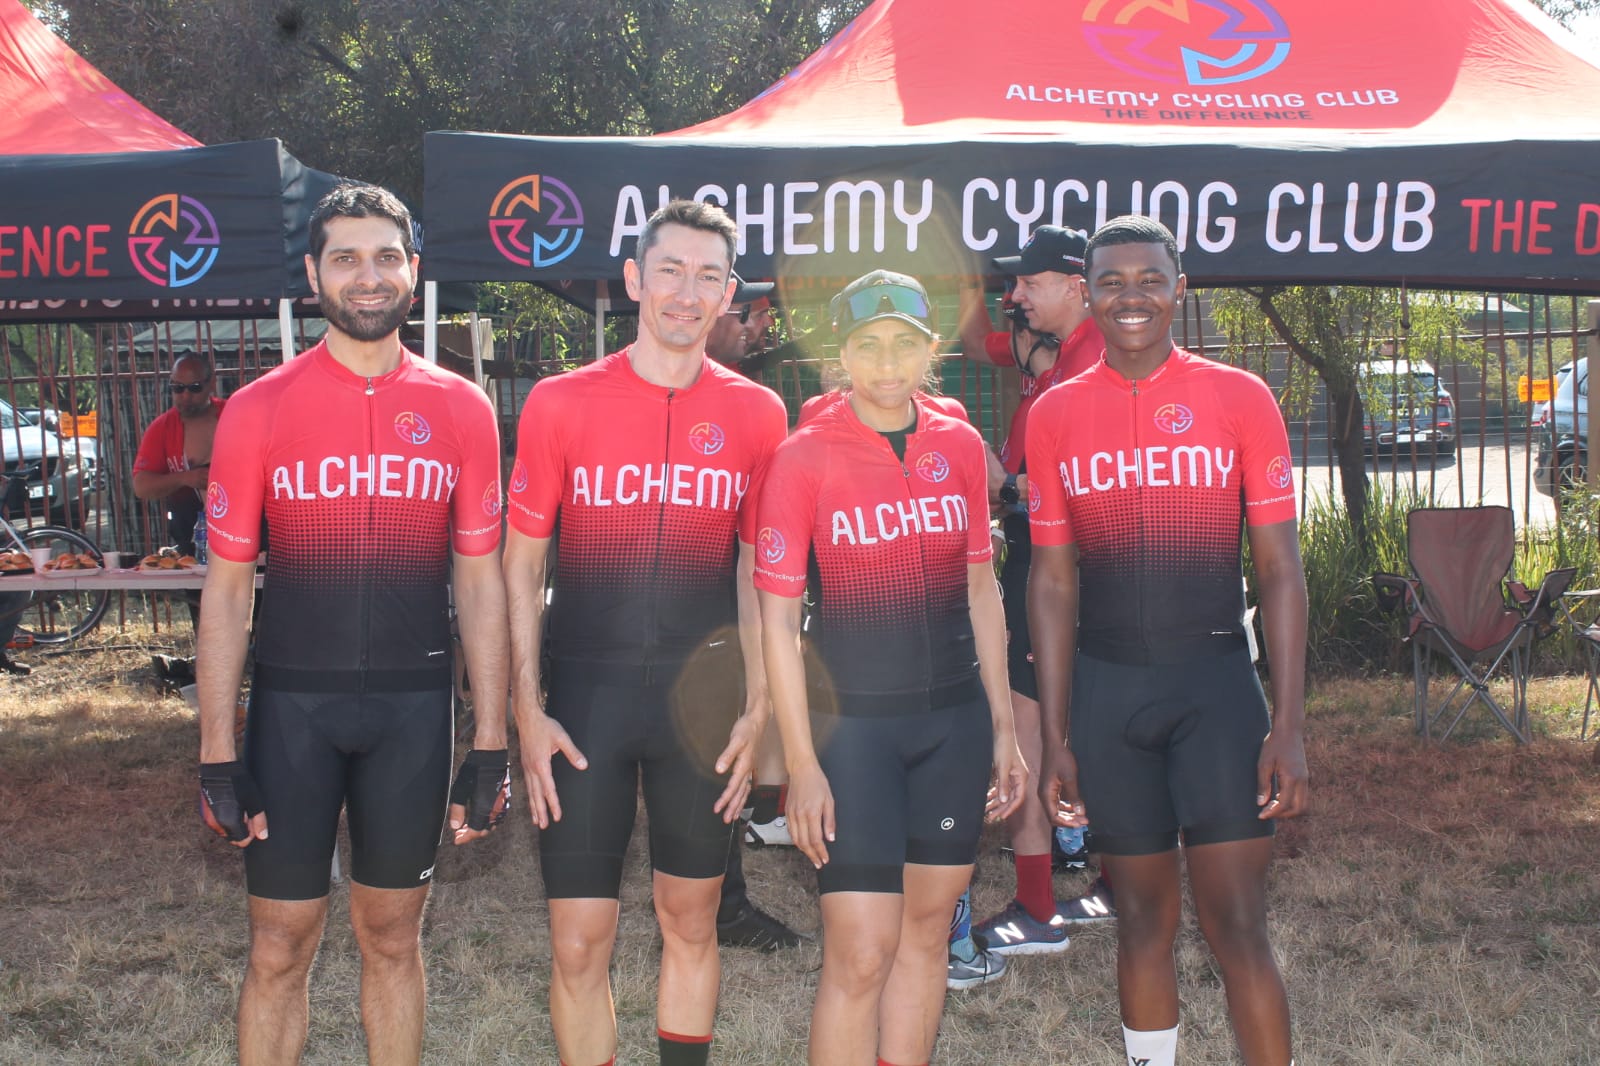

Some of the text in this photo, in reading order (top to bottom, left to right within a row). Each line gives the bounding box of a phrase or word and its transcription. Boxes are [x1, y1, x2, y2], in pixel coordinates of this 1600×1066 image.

[1006, 84, 1399, 108] ALCHEMY CYCLING CLUB
[1101, 108, 1314, 121] THE DIFFERENCE
[609, 178, 933, 257] AHEMY
[1265, 181, 1436, 253] CLUB
[1461, 199, 1557, 255] THE
[272, 453, 461, 503] ALCHEMY
[572, 463, 750, 511] ALCHEMY
[1060, 445, 1234, 500] ALCHEMY
[831, 494, 968, 545] ALCHEM
